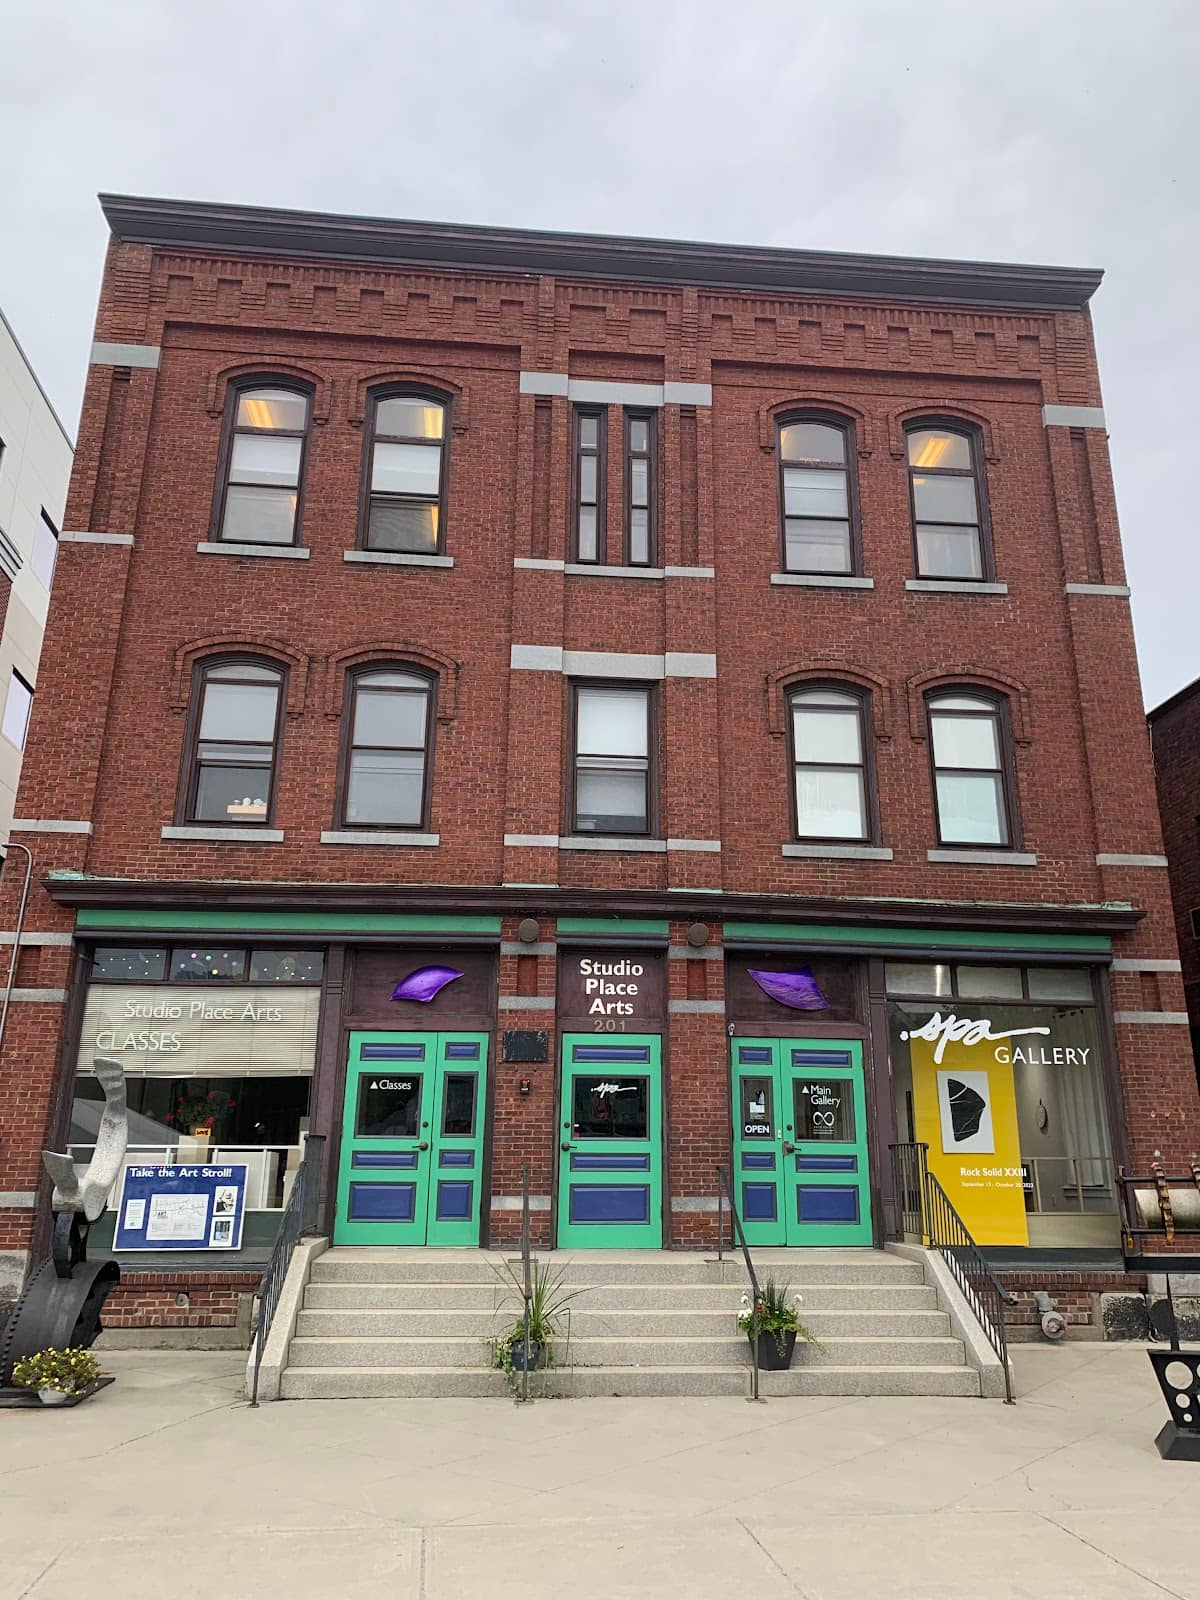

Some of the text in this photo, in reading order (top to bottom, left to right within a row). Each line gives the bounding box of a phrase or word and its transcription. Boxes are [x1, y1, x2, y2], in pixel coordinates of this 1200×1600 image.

[579, 958, 644, 976] Studio
[585, 978, 638, 995] Place
[124, 1000, 283, 1021] Studio Place Arts
[588, 998, 634, 1015] Arts
[593, 1020, 625, 1032] 201
[95, 1031, 182, 1051] CLASSES
[994, 1046, 1090, 1065] GALLERY
[379, 1079, 412, 1090] Classes
[810, 1085, 831, 1095] Main
[810, 1094, 841, 1108] Gallery
[744, 1124, 770, 1134] OPEN
[129, 1167, 232, 1178] Take the Art Stroll!
[960, 1167, 1027, 1177] Rock Solid XXIII
